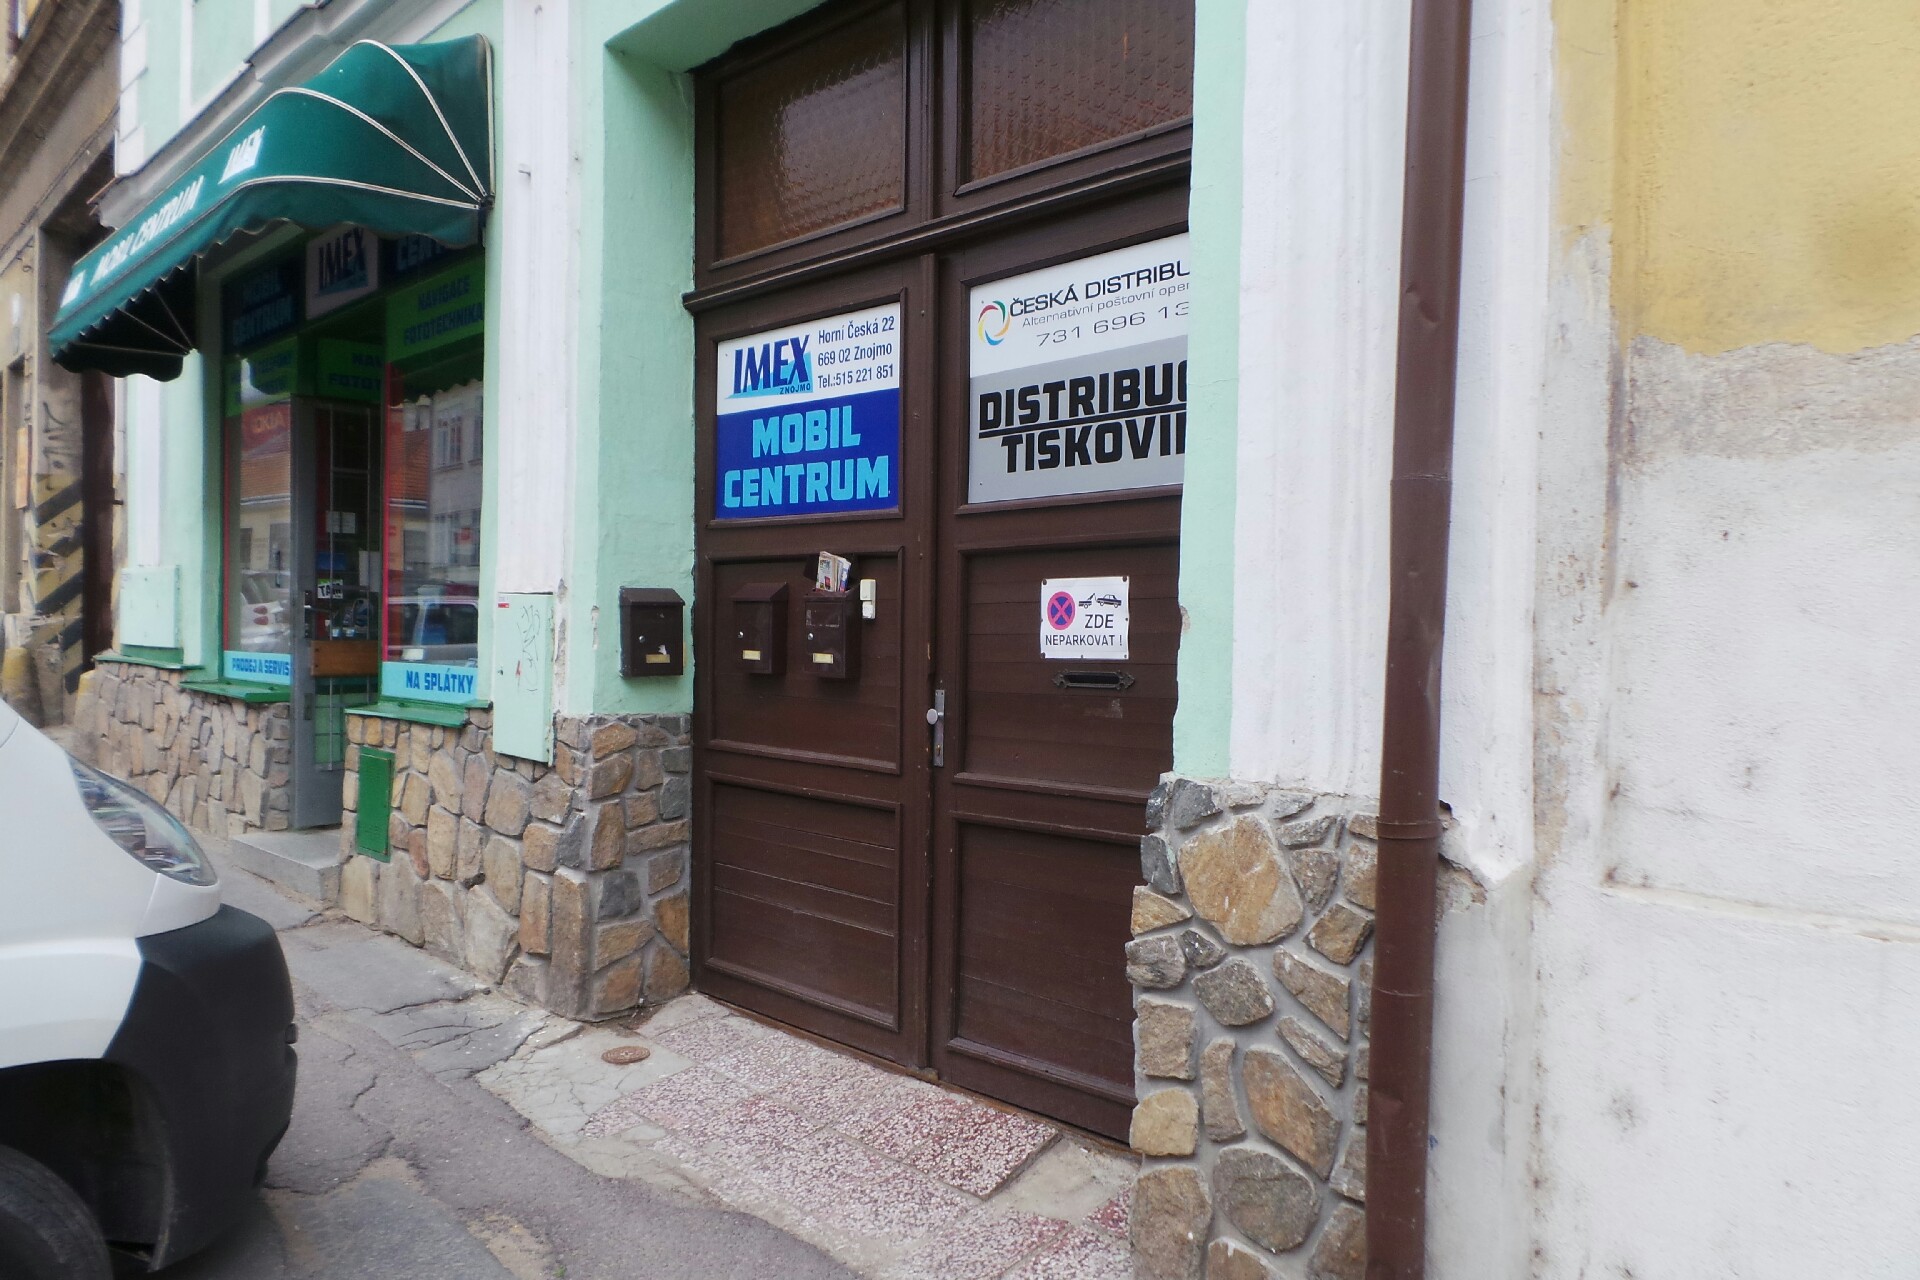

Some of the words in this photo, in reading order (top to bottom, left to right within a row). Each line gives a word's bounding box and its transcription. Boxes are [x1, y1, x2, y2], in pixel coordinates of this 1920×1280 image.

[319, 227, 366, 290] IMEX
[1009, 284, 1079, 317] ČESKÁ
[1022, 303, 1094, 328] Alternativní
[1097, 288, 1155, 313] poštovní
[818, 324, 845, 345] Horní
[847, 317, 879, 339] Česká
[881, 315, 895, 332] 22
[1036, 325, 1081, 347] 731
[1093, 312, 1146, 335] 696
[733, 334, 810, 394] IMEX
[818, 352, 836, 367] 669
[838, 348, 851, 363] 02
[854, 342, 893, 361] Znojmo
[779, 383, 811, 395] ZNOJMO
[818, 370, 853, 389] Tel.:515
[856, 367, 873, 384] 221
[876, 364, 894, 380] 851
[752, 405, 861, 458] MOBIL
[724, 455, 889, 508] CENTRUM
[1084, 614, 1114, 629] ZDE
[1045, 634, 1115, 646] NEPARKOVAT
[232, 658, 257, 673] PRODEJ
[258, 659, 264, 673] A
[264, 659, 289, 676] SERVIS
[406, 669, 419, 690] NA
[424, 668, 474, 694] SPLÁTKY
